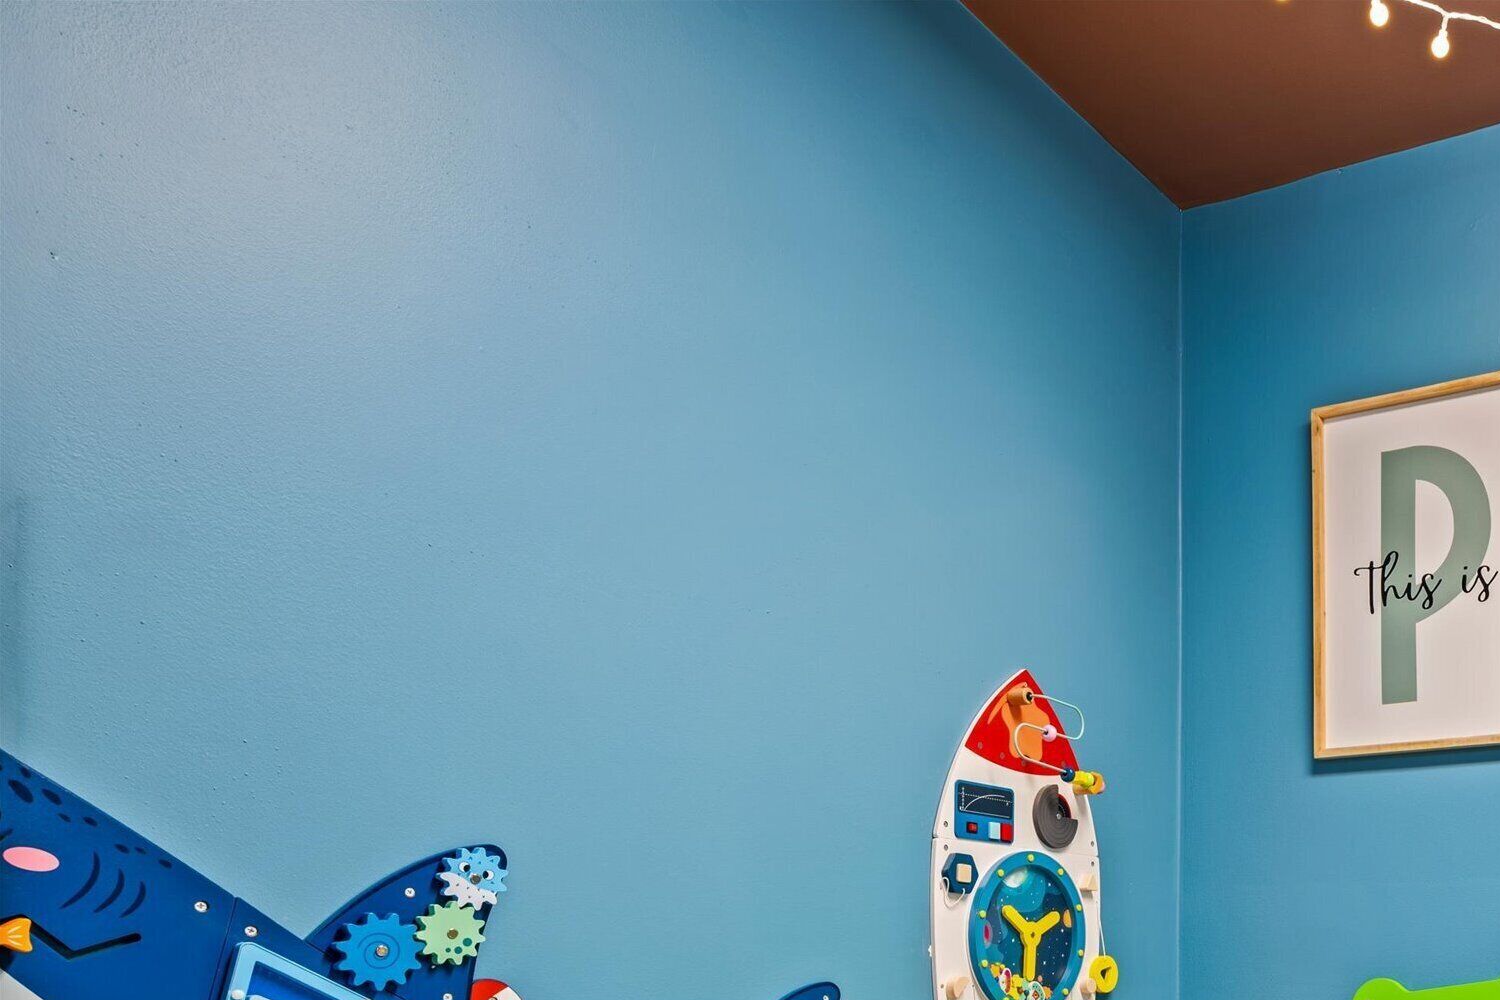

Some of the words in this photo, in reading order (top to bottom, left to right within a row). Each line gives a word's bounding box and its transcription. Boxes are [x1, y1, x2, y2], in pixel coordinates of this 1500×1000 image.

[1353, 550, 1443, 616] This
[1460, 564, 1500, 603] is
[1380, 444, 1492, 706] P
